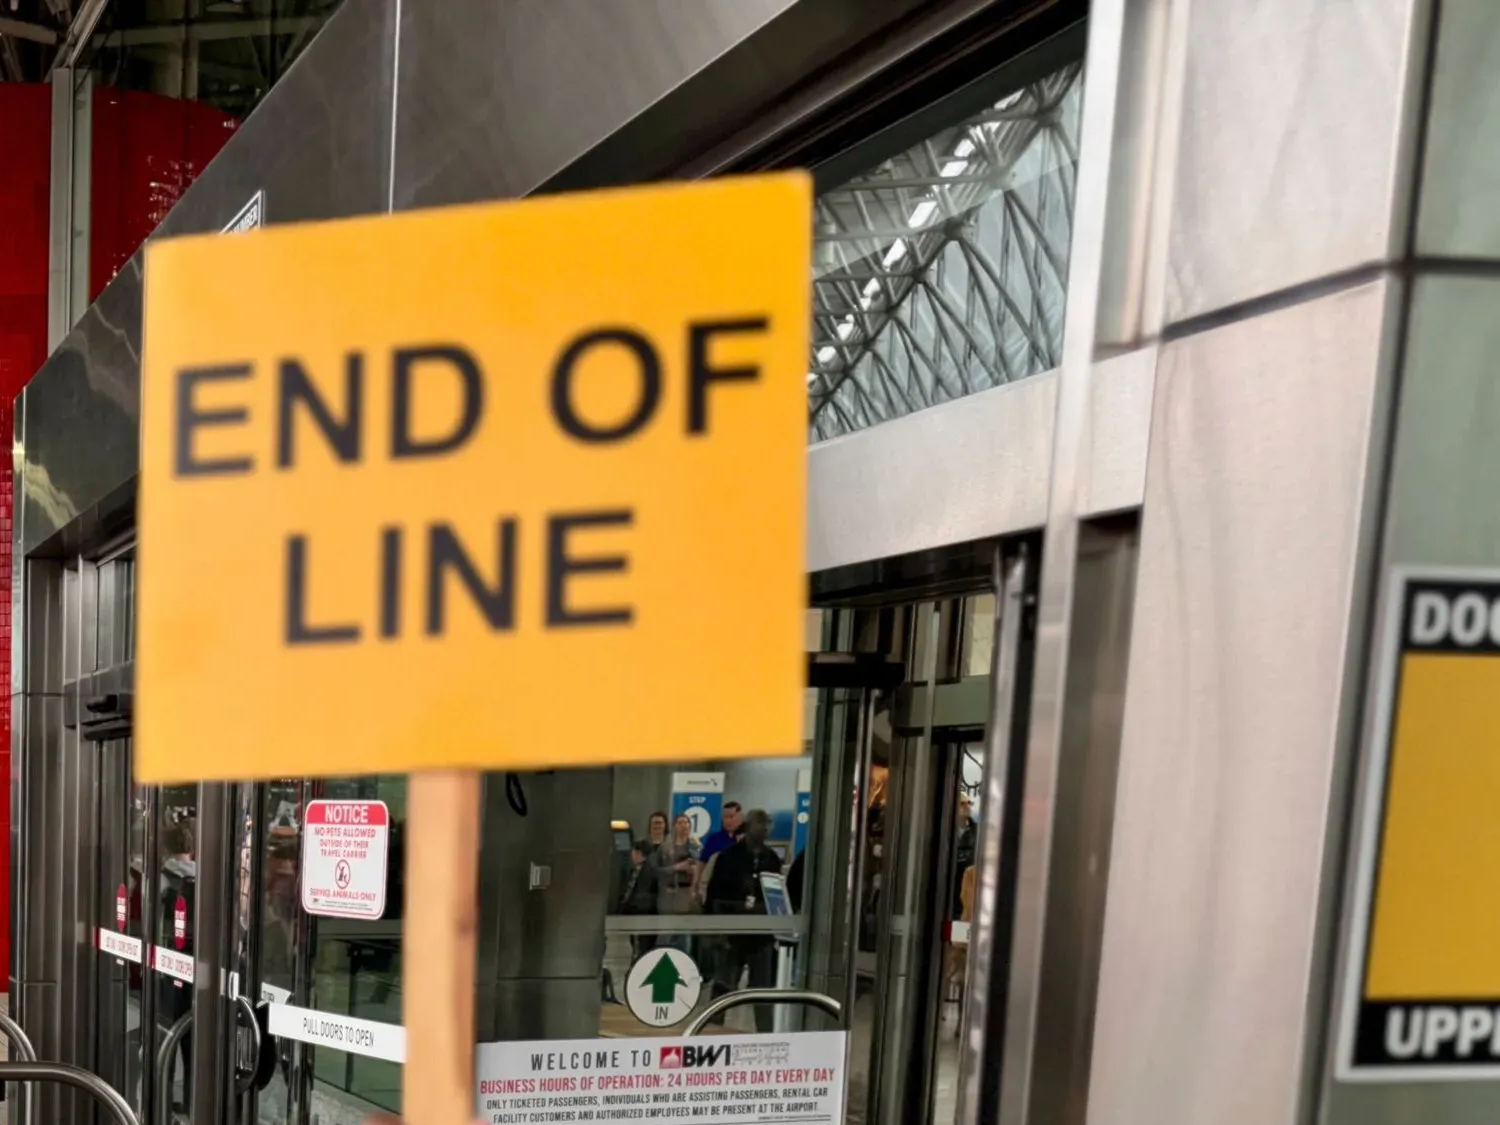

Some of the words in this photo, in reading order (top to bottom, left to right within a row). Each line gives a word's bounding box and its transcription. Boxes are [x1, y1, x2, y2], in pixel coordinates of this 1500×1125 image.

[170, 342, 486, 479] END
[547, 316, 772, 444] OF
[283, 508, 635, 647] LINE
[325, 805, 369, 823] NOTICE
[690, 813, 700, 832] 1
[314, 827, 325, 836] NO
[326, 827, 341, 837] PETS
[343, 828, 376, 838] ALLOWED
[320, 839, 342, 848] OUTSIDE
[344, 840, 352, 848] OF
[353, 840, 369, 849] THEIR
[343, 850, 367, 859] CARRIER
[332, 889, 359, 899] ANIMALS
[360, 892, 377, 901] ONLY
[654, 1006, 668, 1020] IN
[303, 1017, 318, 1036] PULL
[320, 1020, 344, 1041] DOORS
[345, 1026, 354, 1043] TO
[355, 1028, 375, 1047] OPEN
[531, 1051, 620, 1071] WELCOME
[630, 1050, 652, 1068] TO
[682, 1044, 731, 1068] BWI
[480, 1078, 536, 1094] BUSINESS
[540, 1076, 576, 1092] HOURS
[580, 1076, 594, 1090] OF
[598, 1073, 664, 1090] OPERATION:
[668, 1073, 682, 1088] 24
[686, 1071, 722, 1086] HOURS
[726, 1070, 746, 1085] PER
[750, 1070, 772, 1084] DAY
[776, 1068, 810, 1083] EVERY
[813, 1068, 836, 1082] DAY
[487, 1099, 507, 1110] ONLY
[510, 1097, 546, 1110] TICKETED
[548, 1096, 600, 1108] PASSENGERS,
[602, 1094, 650, 1105] INDIVIDUALS
[652, 1092, 670, 1103] WHO
[672, 1090, 686, 1102] ARE
[689, 1090, 728, 1102] ASSISTING
[730, 1088, 780, 1100] PASSENGERS,
[782, 1087, 810, 1098] RENTAL
[813, 1086, 828, 1097] CAR
[494, 1112, 527, 1124] FACILITY
[530, 1110, 576, 1123] CUSTOMERS
[578, 1110, 594, 1121] AND
[596, 1108, 643, 1120] AUTHORIZED
[646, 1106, 690, 1118] EMPLOYEES
[692, 1105, 709, 1116] MAY
[711, 1104, 720, 1116] BE
[722, 1103, 757, 1115] PRESENT
[758, 1102, 769, 1114] AT
[770, 1102, 784, 1113] THE
